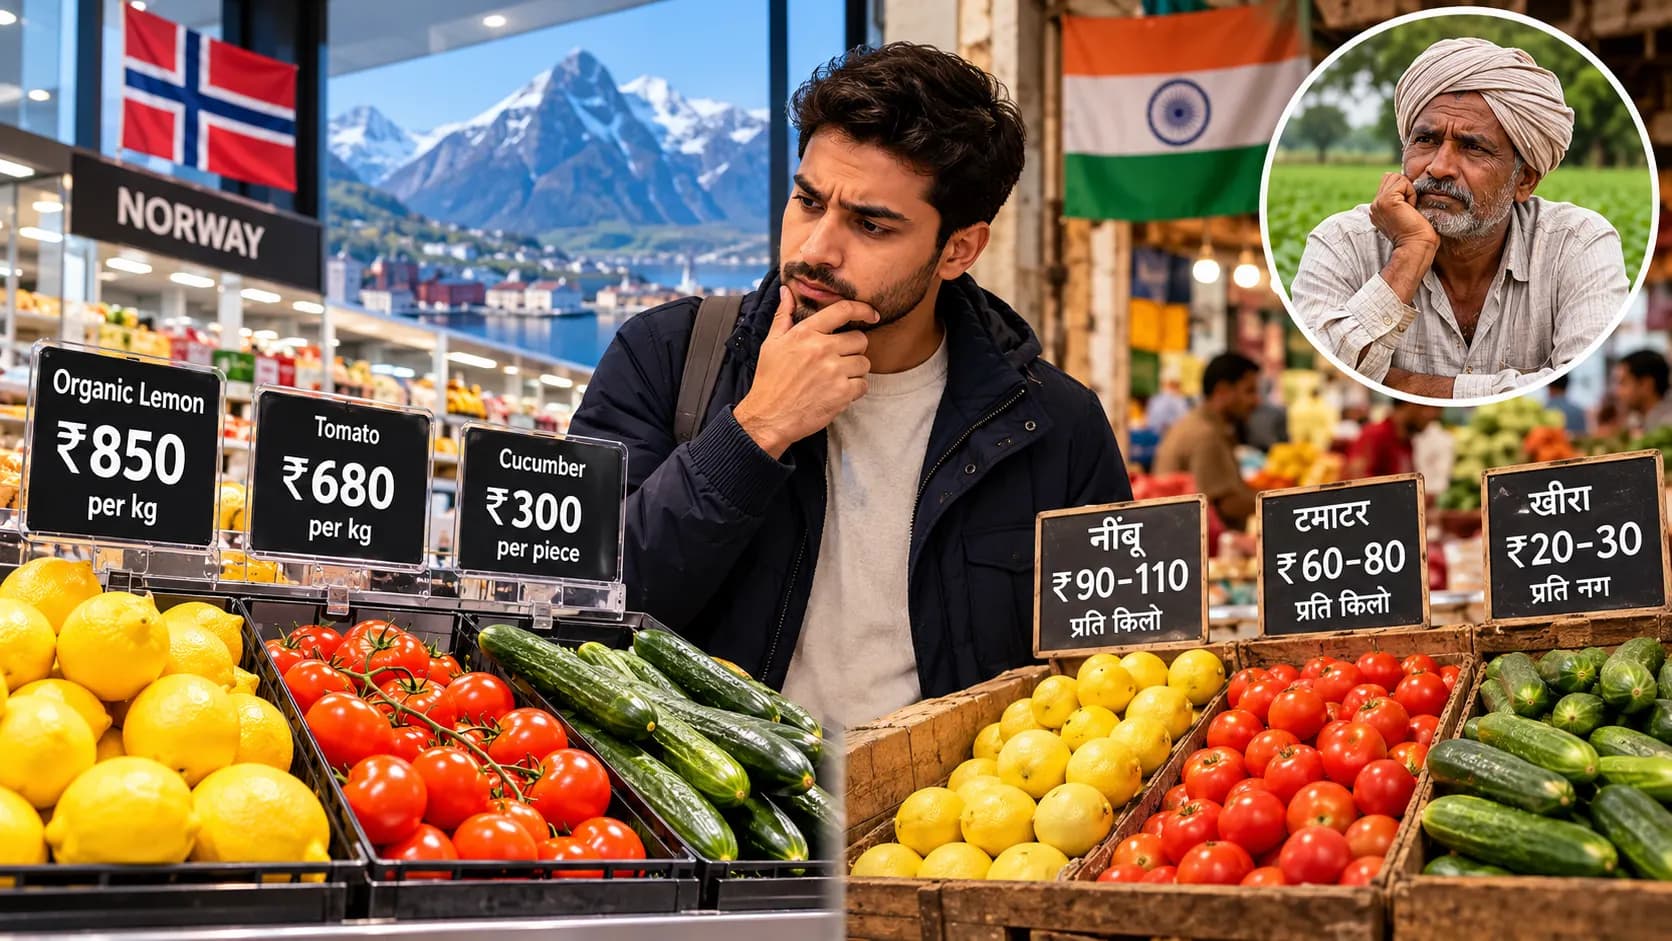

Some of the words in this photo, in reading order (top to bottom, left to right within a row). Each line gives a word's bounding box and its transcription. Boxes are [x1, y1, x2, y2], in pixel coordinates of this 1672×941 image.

[118, 187, 265, 259] NORWAY
[53, 368, 134, 404] Organic
[139, 381, 205, 414] Lemon
[314, 415, 380, 445] Tomato
[56, 420, 186, 485] ₹850
[499, 447, 586, 478] Cucumber
[282, 455, 395, 510] ₹680
[1529, 481, 1593, 517] खीरा
[87, 495, 126, 521] per
[131, 493, 158, 526] kg
[486, 486, 582, 534] ₹300
[1293, 500, 1371, 532] टमाटर
[308, 519, 343, 542] per
[348, 517, 372, 546] kg
[1087, 515, 1147, 558] नींबू
[496, 540, 528, 561] per
[532, 540, 580, 564] piece
[1294, 591, 1334, 622] प्रति
[1338, 585, 1392, 617] किलो
[1530, 574, 1570, 605] प्रति
[1575, 576, 1612, 600] नग
[1069, 608, 1107, 639] प्रति
[1111, 603, 1164, 635] किलो
